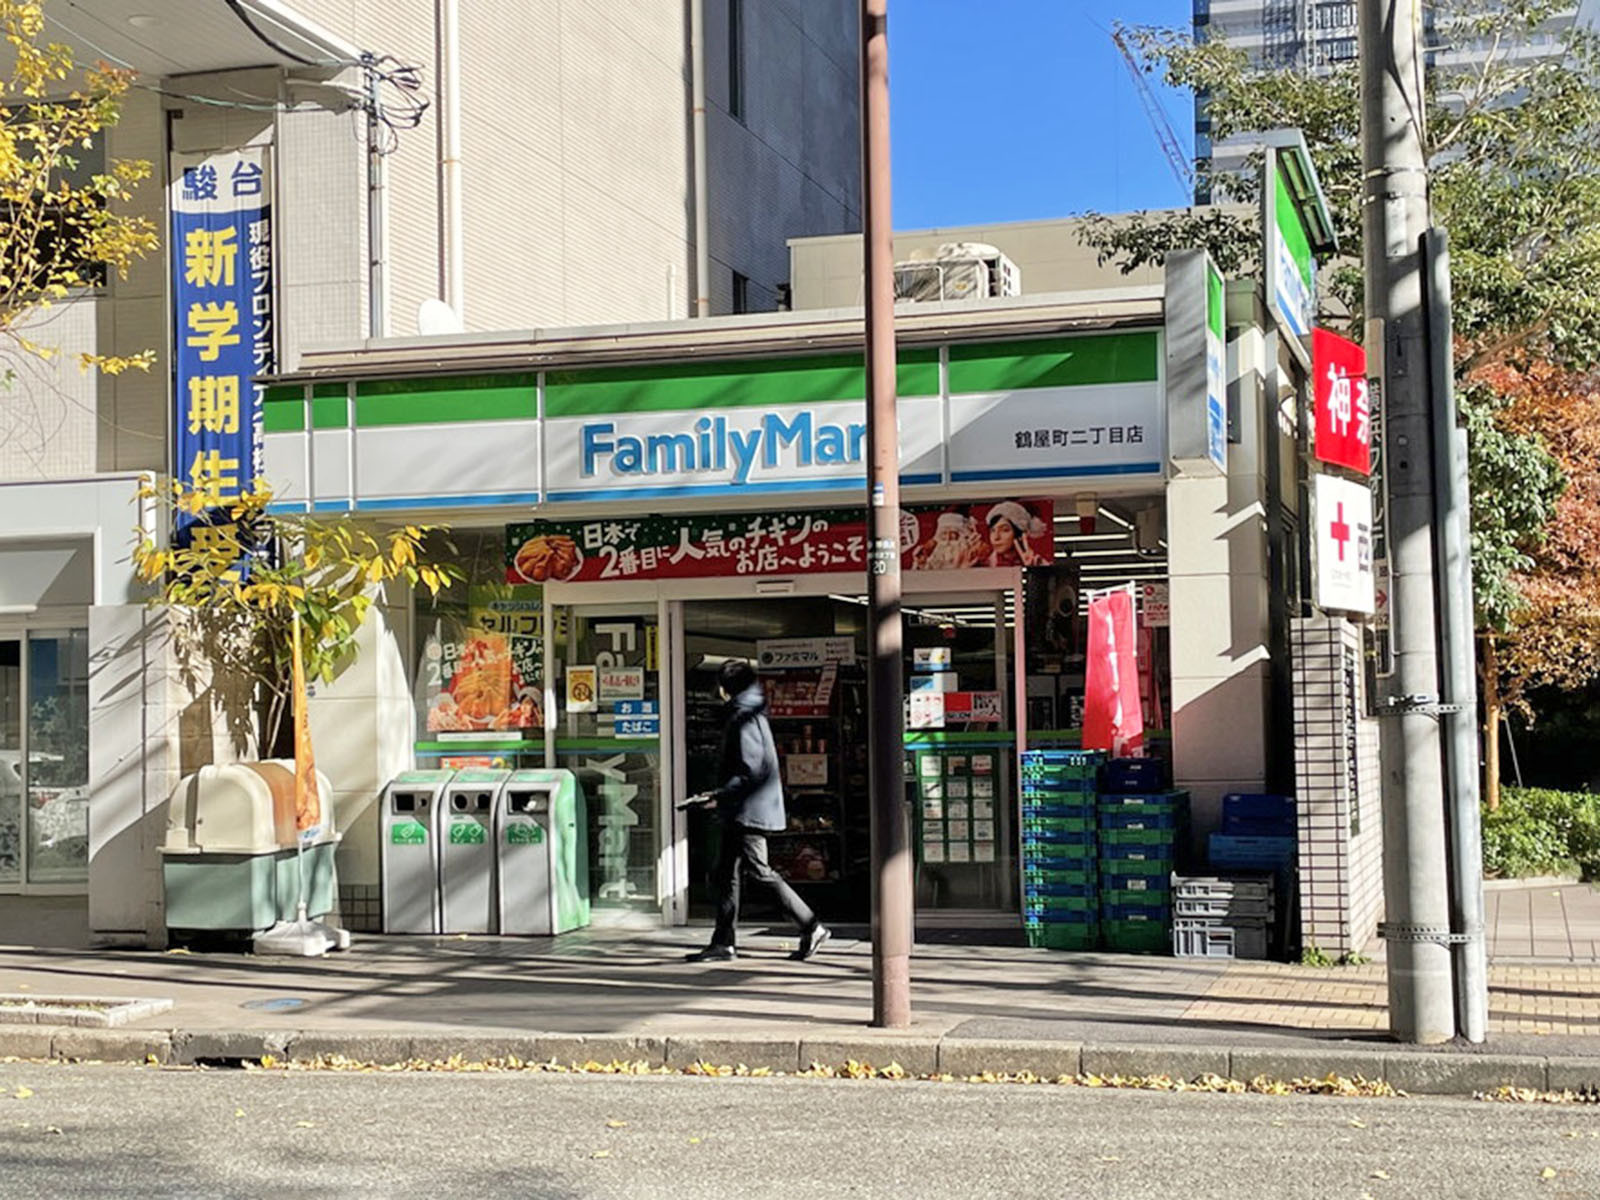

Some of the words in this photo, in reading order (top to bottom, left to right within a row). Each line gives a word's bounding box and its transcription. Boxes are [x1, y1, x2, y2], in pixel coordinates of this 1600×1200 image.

[182, 160, 263, 201] 駿台
[580, 411, 867, 485] FamilyMar
[1015, 425, 1143, 448] 鶴屋町二丁目店
